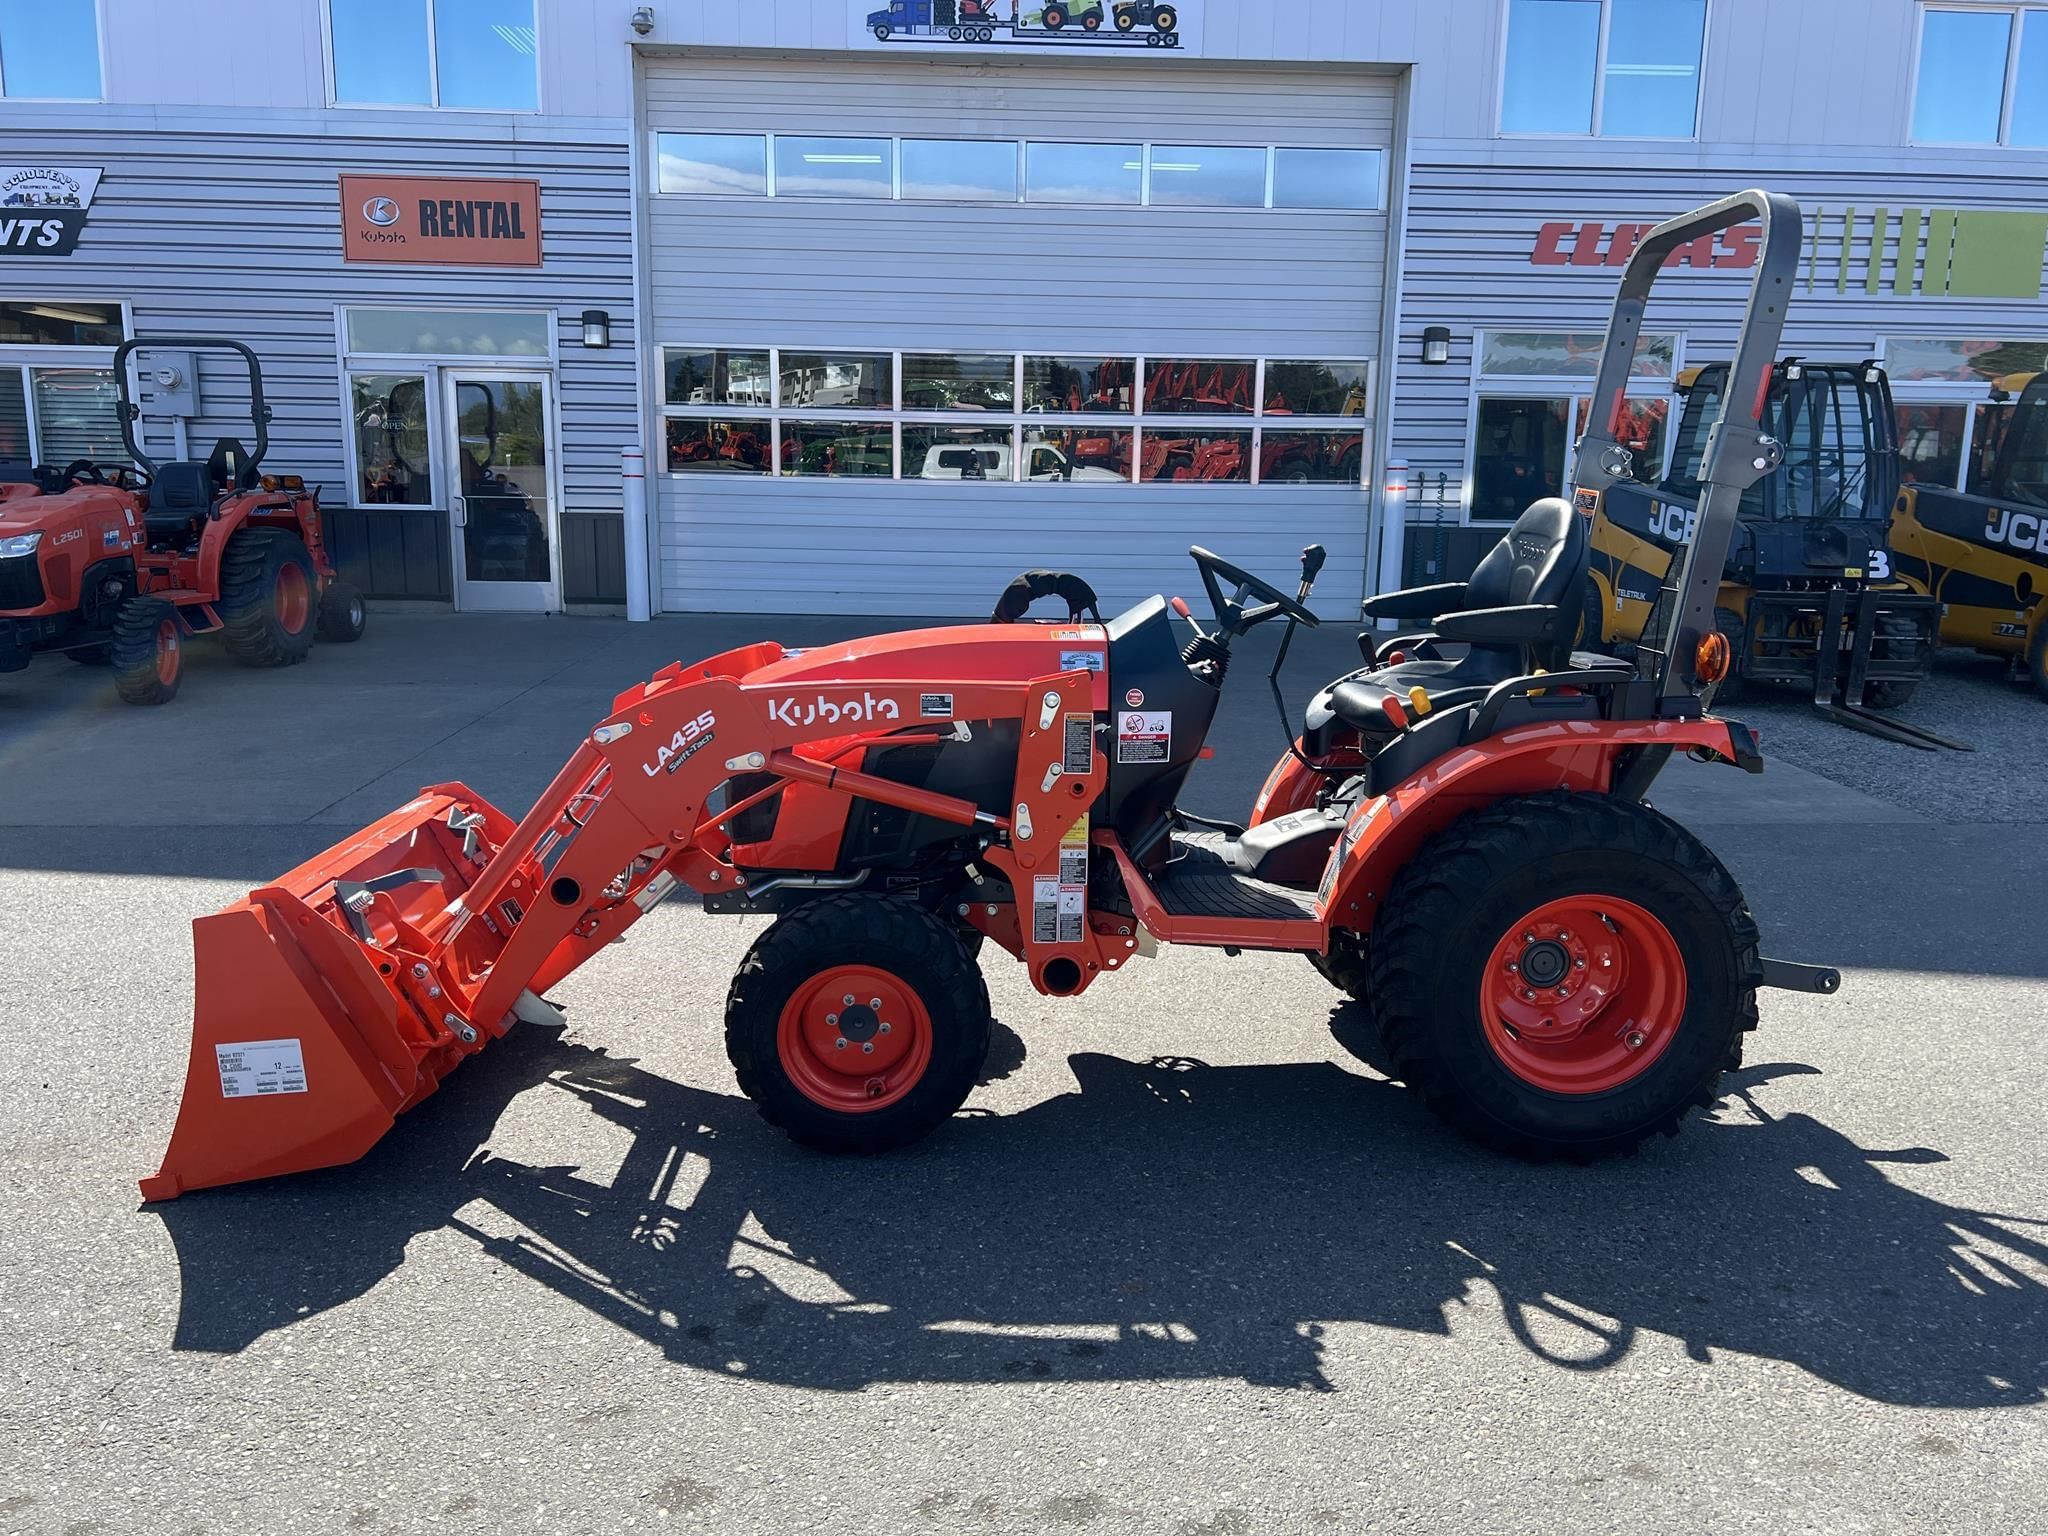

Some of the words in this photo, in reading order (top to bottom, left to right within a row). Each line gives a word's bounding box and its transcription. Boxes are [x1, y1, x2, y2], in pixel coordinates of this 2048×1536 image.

[2, 168, 80, 192] SCHOLTEN'S
[418, 199, 526, 240] RENTAL
[360, 230, 406, 244] Kubota
[381, 421, 408, 431] OPEN
[52, 528, 83, 546] L2501
[1617, 588, 1647, 601] TELETRUK
[2000, 623, 2016, 634] 77
[768, 692, 899, 727] Kubota
[642, 709, 716, 777] LA435
[668, 734, 713, 773] Swift-Tach
